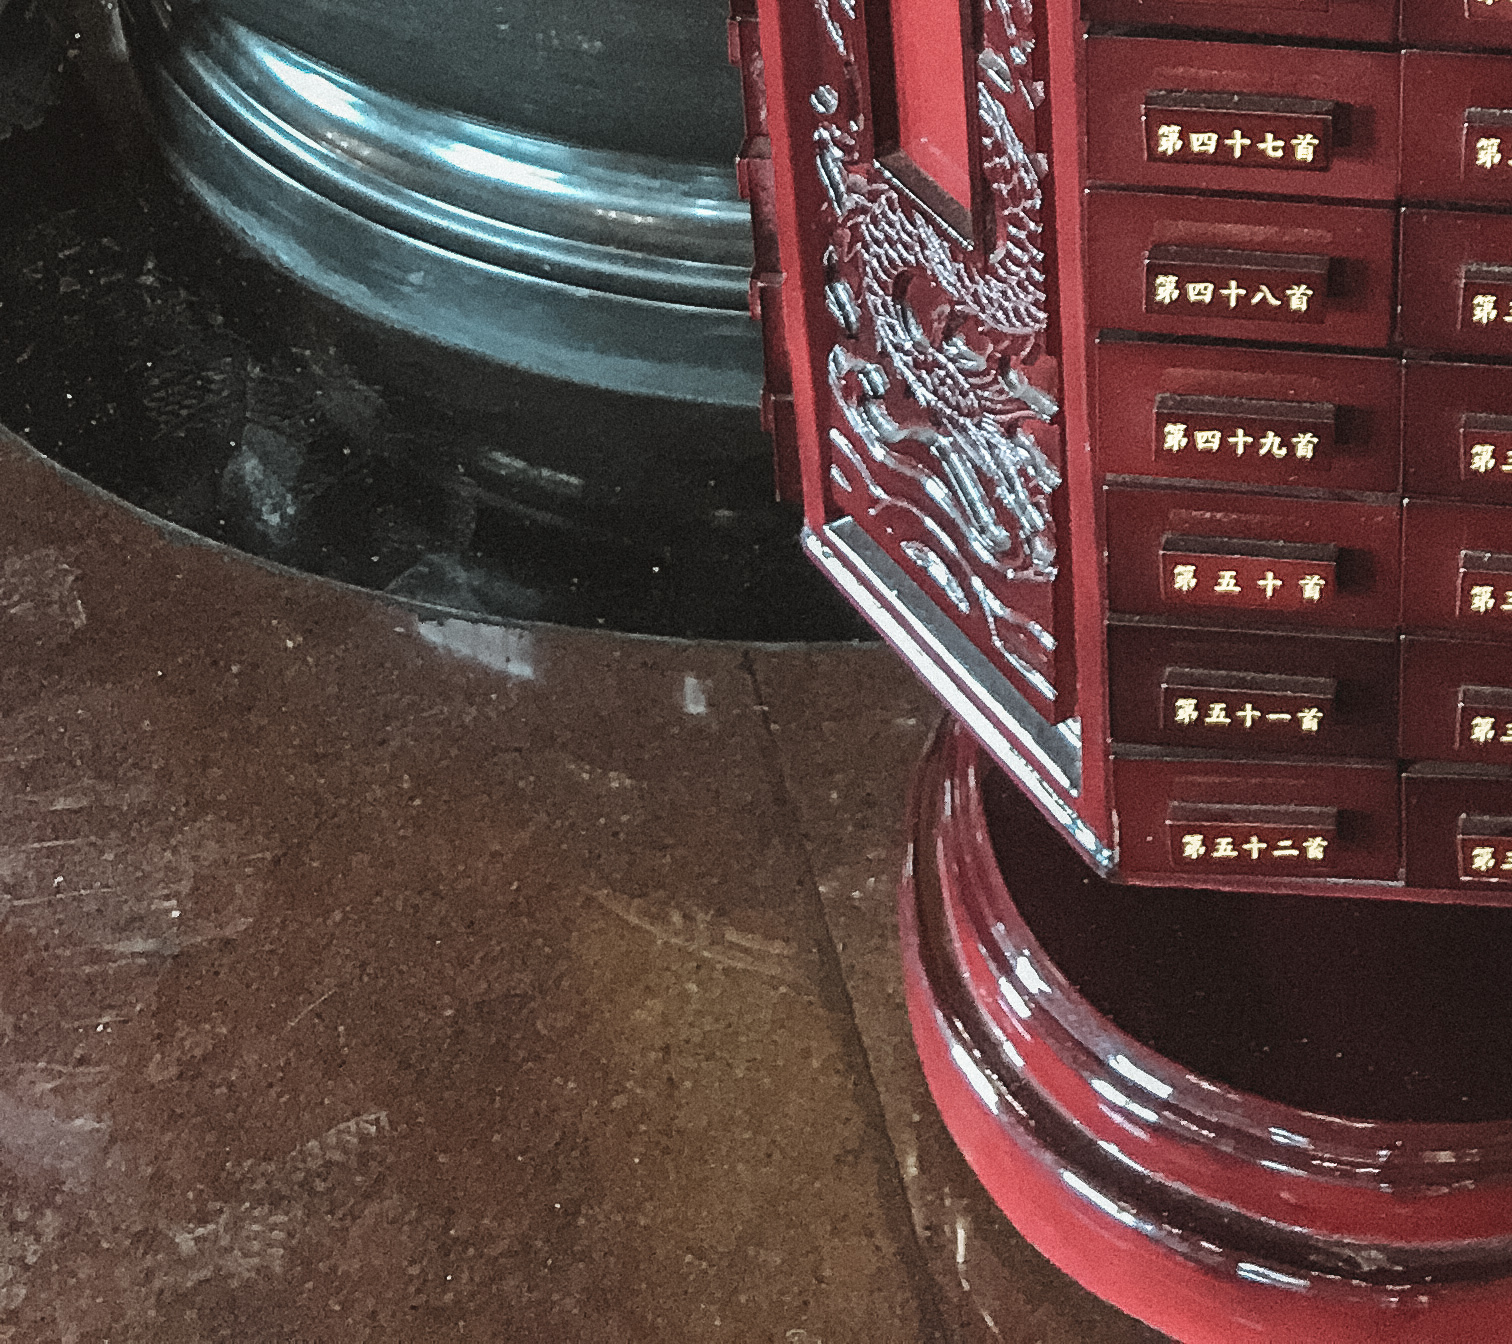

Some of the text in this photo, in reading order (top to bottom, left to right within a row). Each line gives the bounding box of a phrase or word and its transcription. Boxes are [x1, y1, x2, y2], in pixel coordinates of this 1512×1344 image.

[1157, 124, 1320, 163] 第四十七首
[1154, 274, 1314, 312] 第四十八首
[1163, 422, 1319, 459] 第四十九首
[1173, 564, 1326, 601] 第五十首
[1174, 698, 1324, 731] 第五十一首
[1181, 834, 1329, 860] 第五十二首
